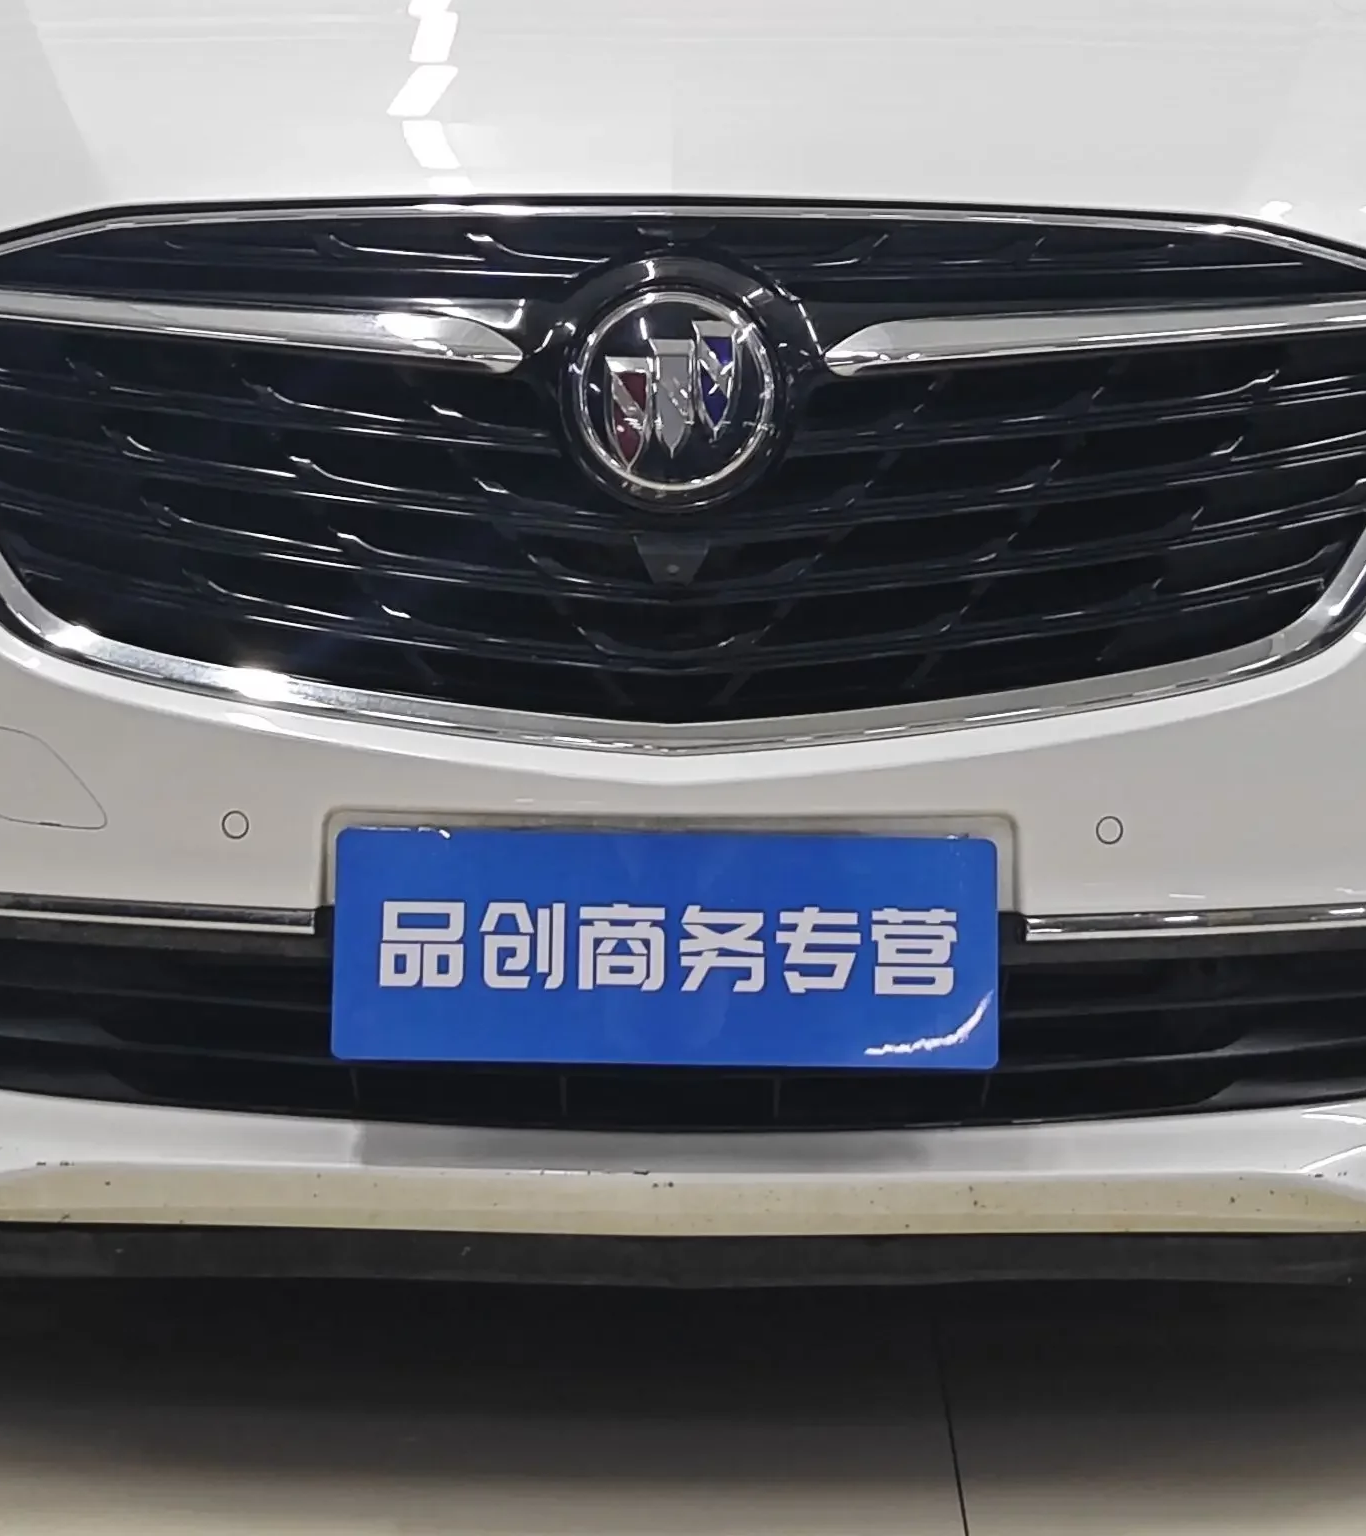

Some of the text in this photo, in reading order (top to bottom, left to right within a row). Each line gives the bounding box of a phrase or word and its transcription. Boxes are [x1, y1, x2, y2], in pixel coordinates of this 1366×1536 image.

[378, 900, 959, 997] 品创商务专营
